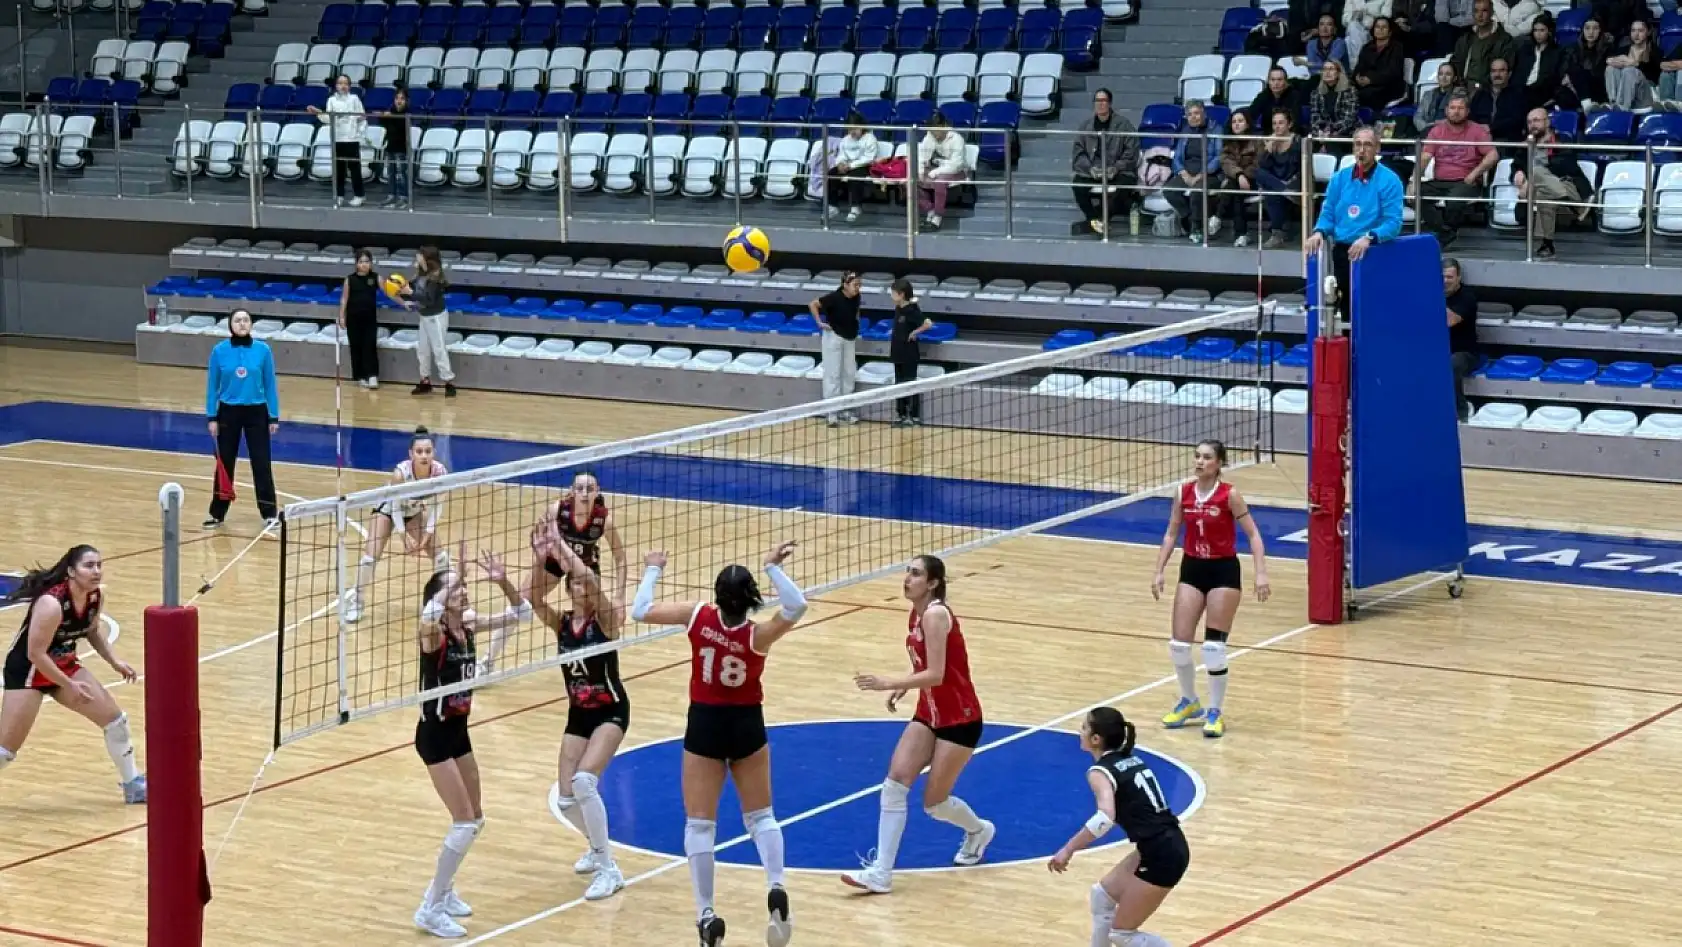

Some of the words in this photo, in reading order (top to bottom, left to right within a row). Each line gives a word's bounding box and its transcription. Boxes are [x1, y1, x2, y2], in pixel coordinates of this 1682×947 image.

[1196, 519, 1204, 537] 1
[699, 646, 747, 687] 18
[1134, 768, 1168, 813] 17
